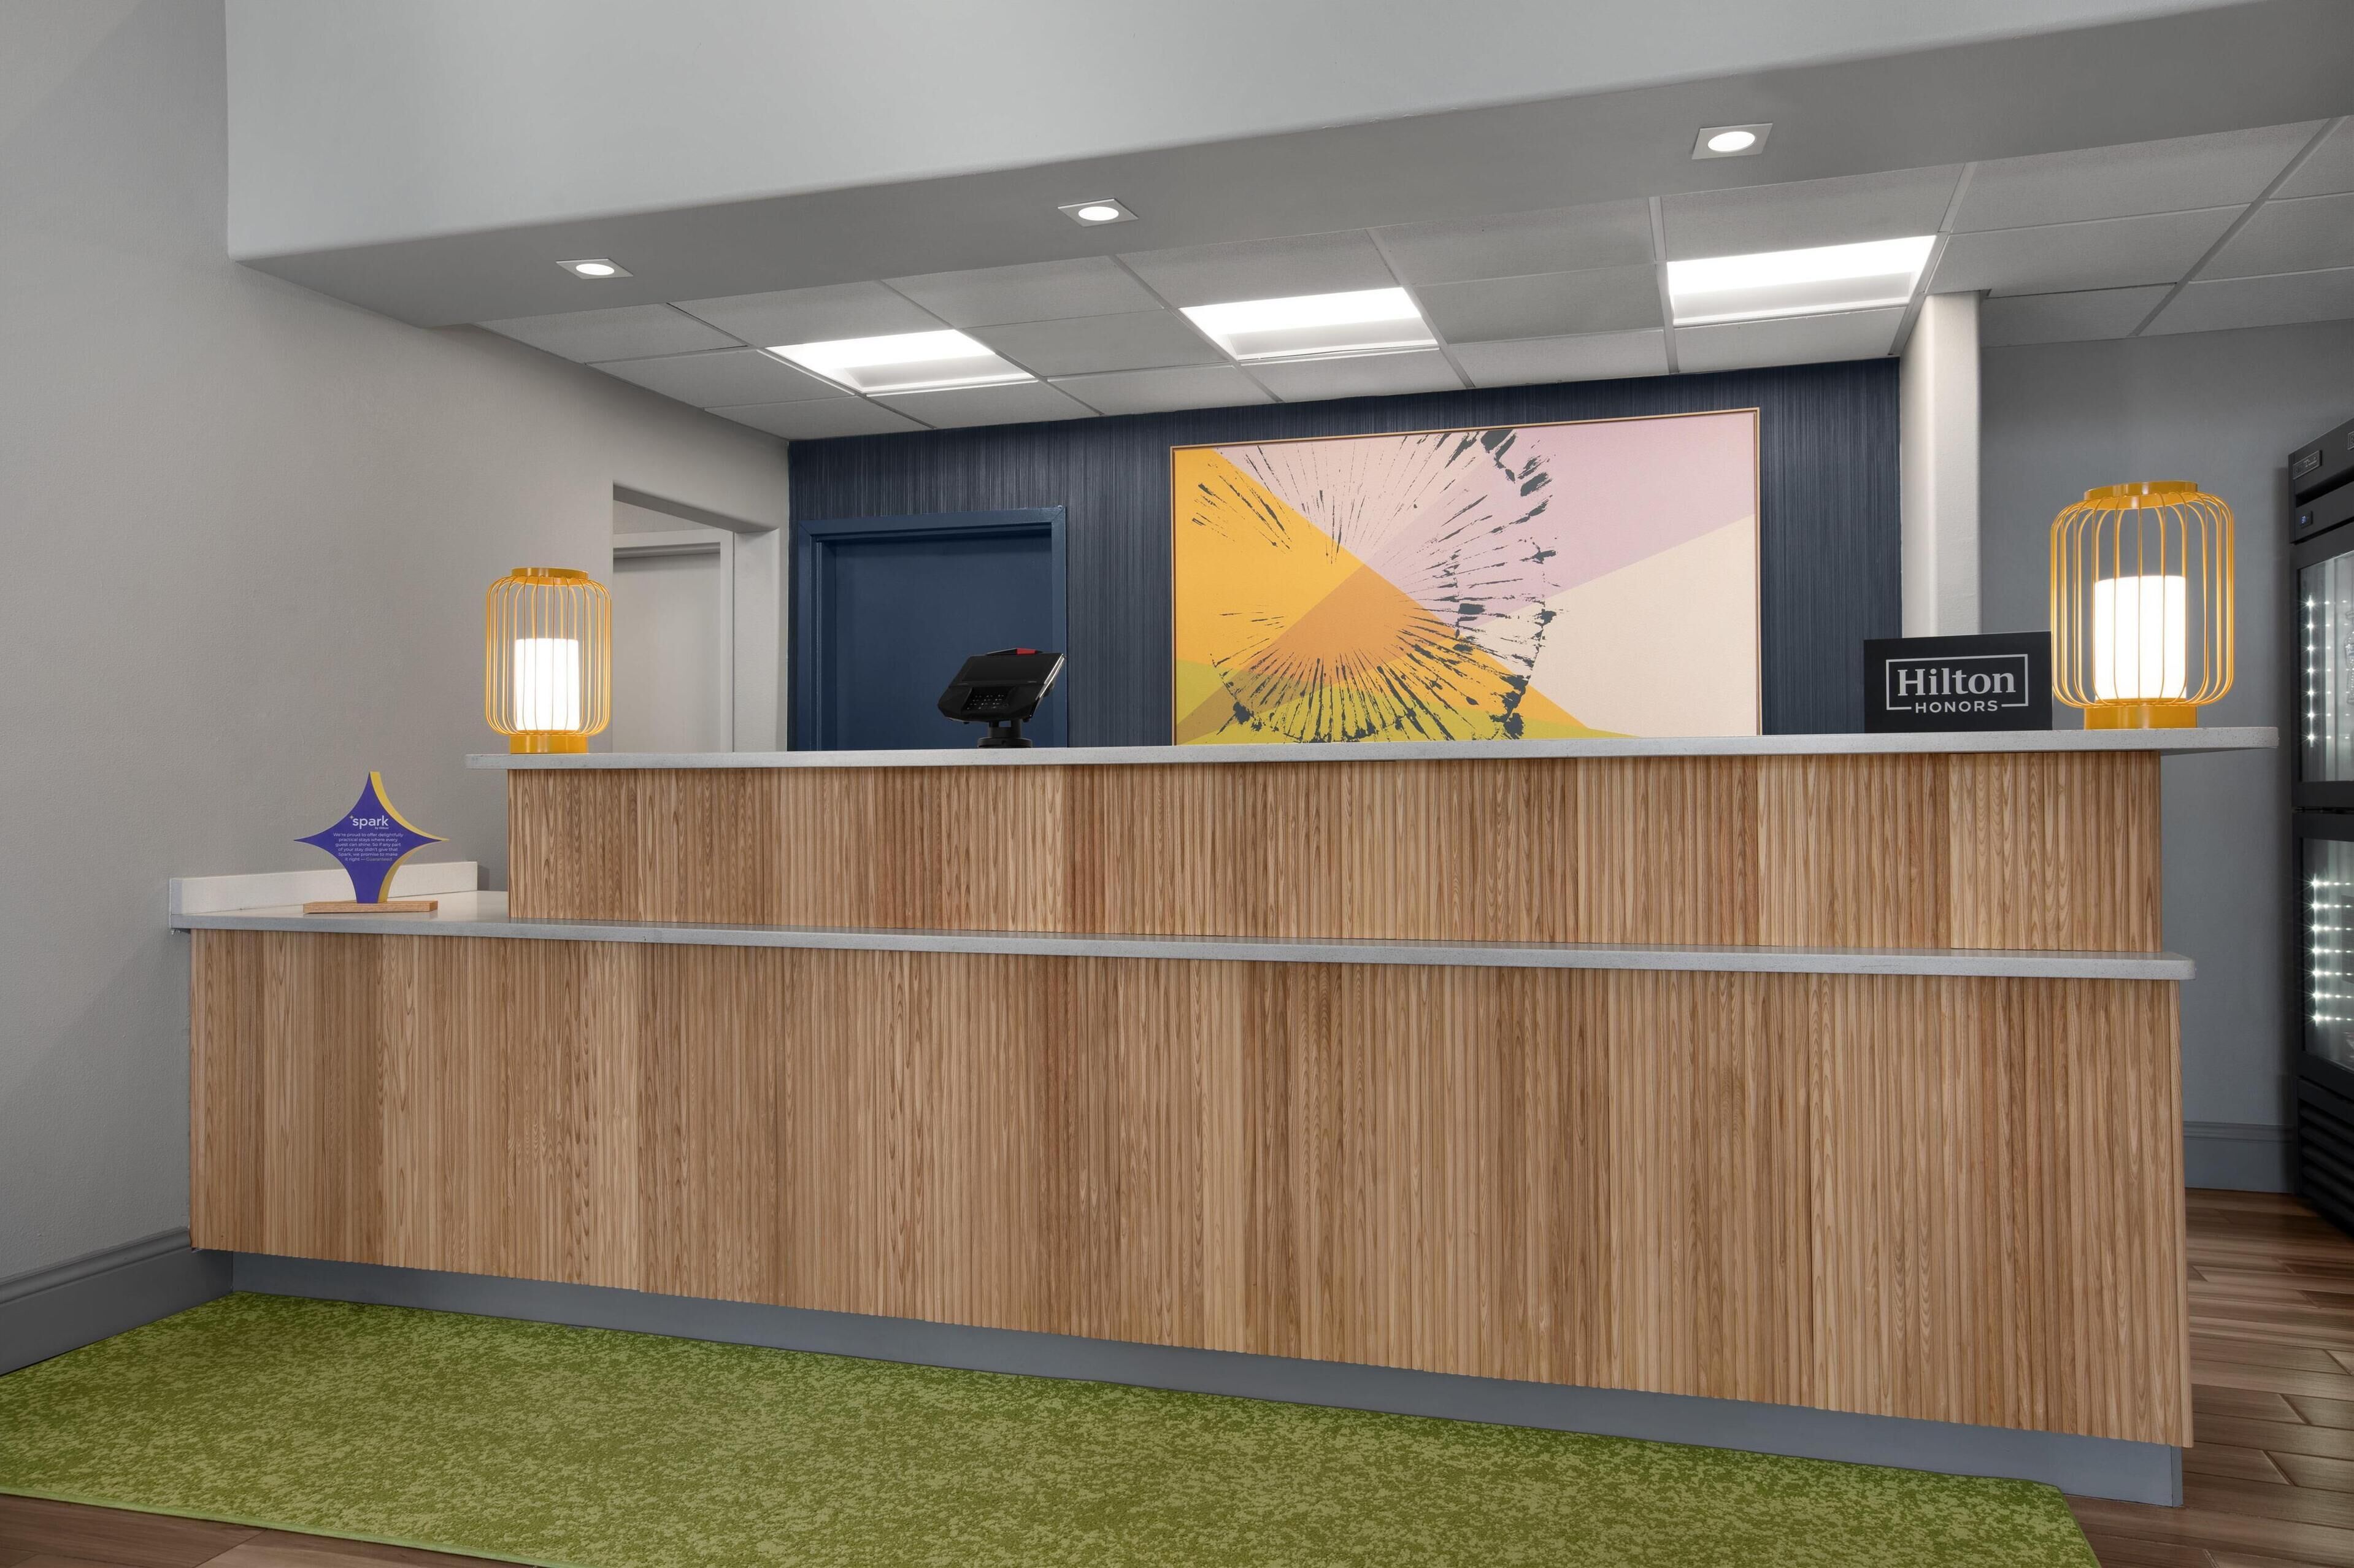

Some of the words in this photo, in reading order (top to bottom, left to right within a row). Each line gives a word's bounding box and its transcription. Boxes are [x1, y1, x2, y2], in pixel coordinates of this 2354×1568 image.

[1897, 667, 2016, 696] Hilton
[1915, 700, 1998, 713] HONORS
[353, 815, 388, 829] spark
